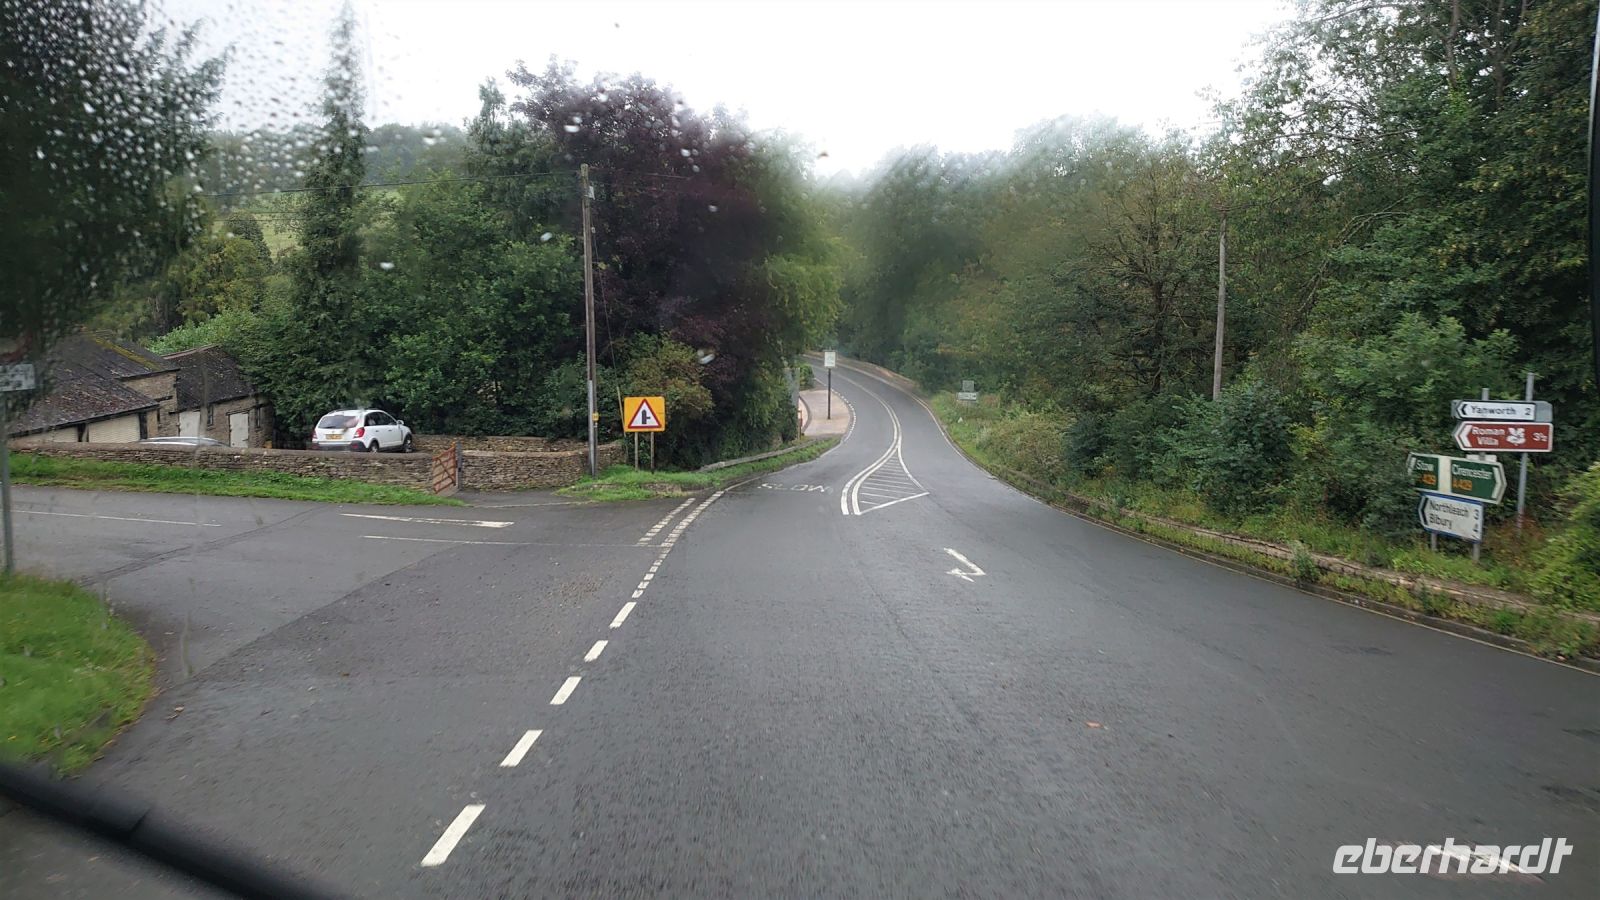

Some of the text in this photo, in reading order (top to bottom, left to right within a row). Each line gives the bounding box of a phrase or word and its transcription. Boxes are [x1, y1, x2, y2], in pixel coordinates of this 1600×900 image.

[1470, 405, 1532, 416] Yanworth 2
[1471, 426, 1506, 436] Roman
[1477, 436, 1500, 446] Villa
[1415, 460, 1435, 472] Stow
[1452, 464, 1493, 479] Cirencester
[1429, 499, 1480, 520] Northleach 3
[1429, 513, 1453, 530] Bibury
